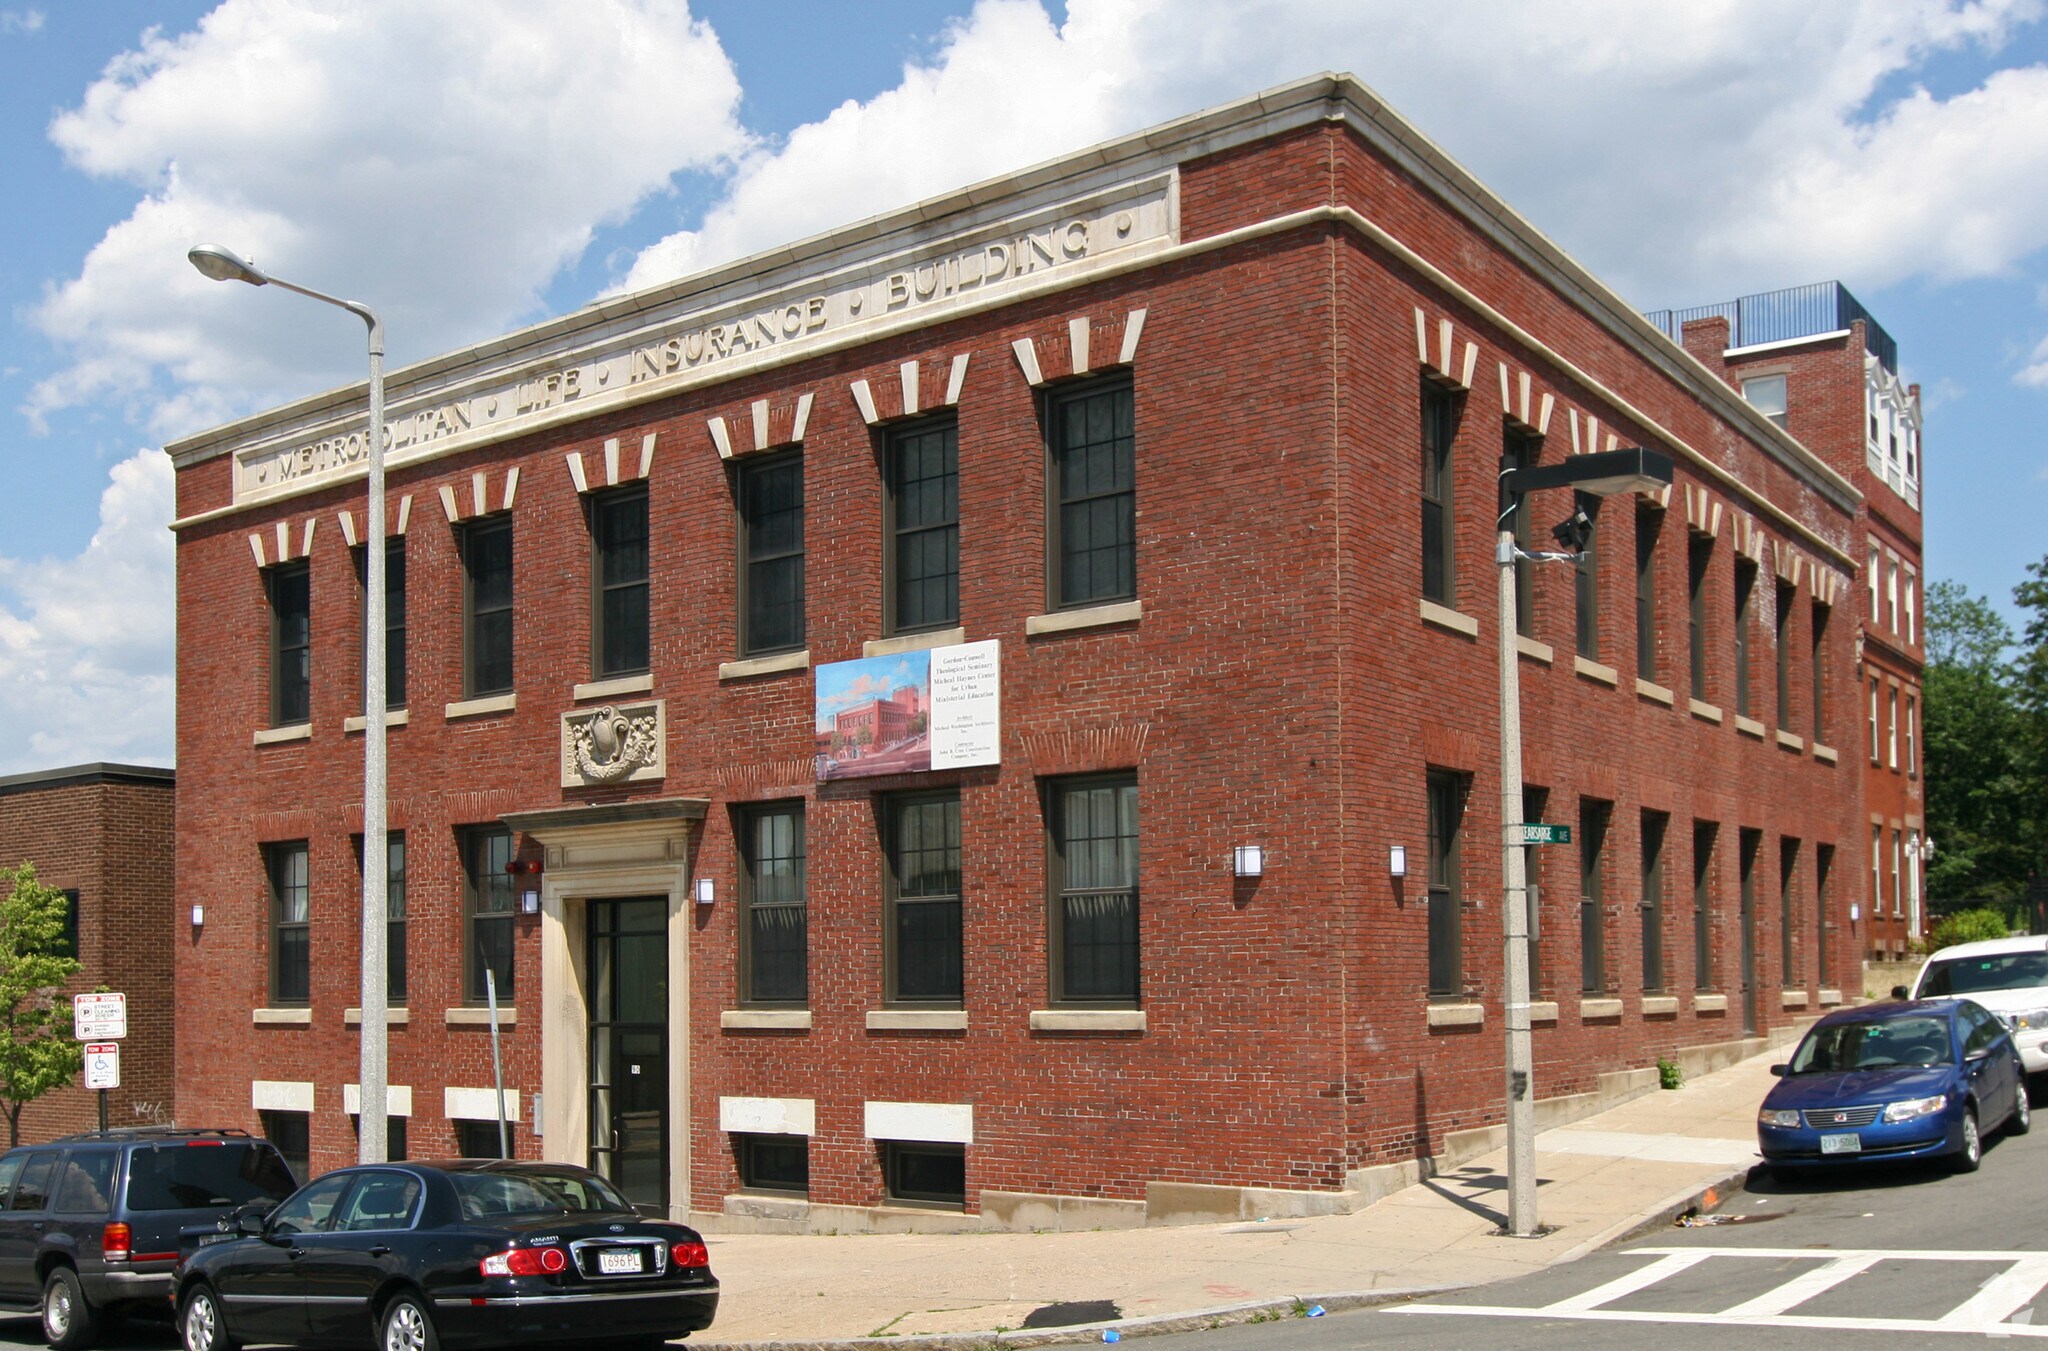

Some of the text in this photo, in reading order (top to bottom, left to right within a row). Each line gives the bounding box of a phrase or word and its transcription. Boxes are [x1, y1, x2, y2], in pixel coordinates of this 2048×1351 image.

[516, 368, 580, 411] LIFE
[630, 295, 827, 380] INSURANCE
[886, 219, 1090, 304] BUILDING
[936, 663, 993, 674] Theological Seminary
[936, 691, 994, 702] Ministerial Education
[1523, 826, 1552, 840] EARSARGE
